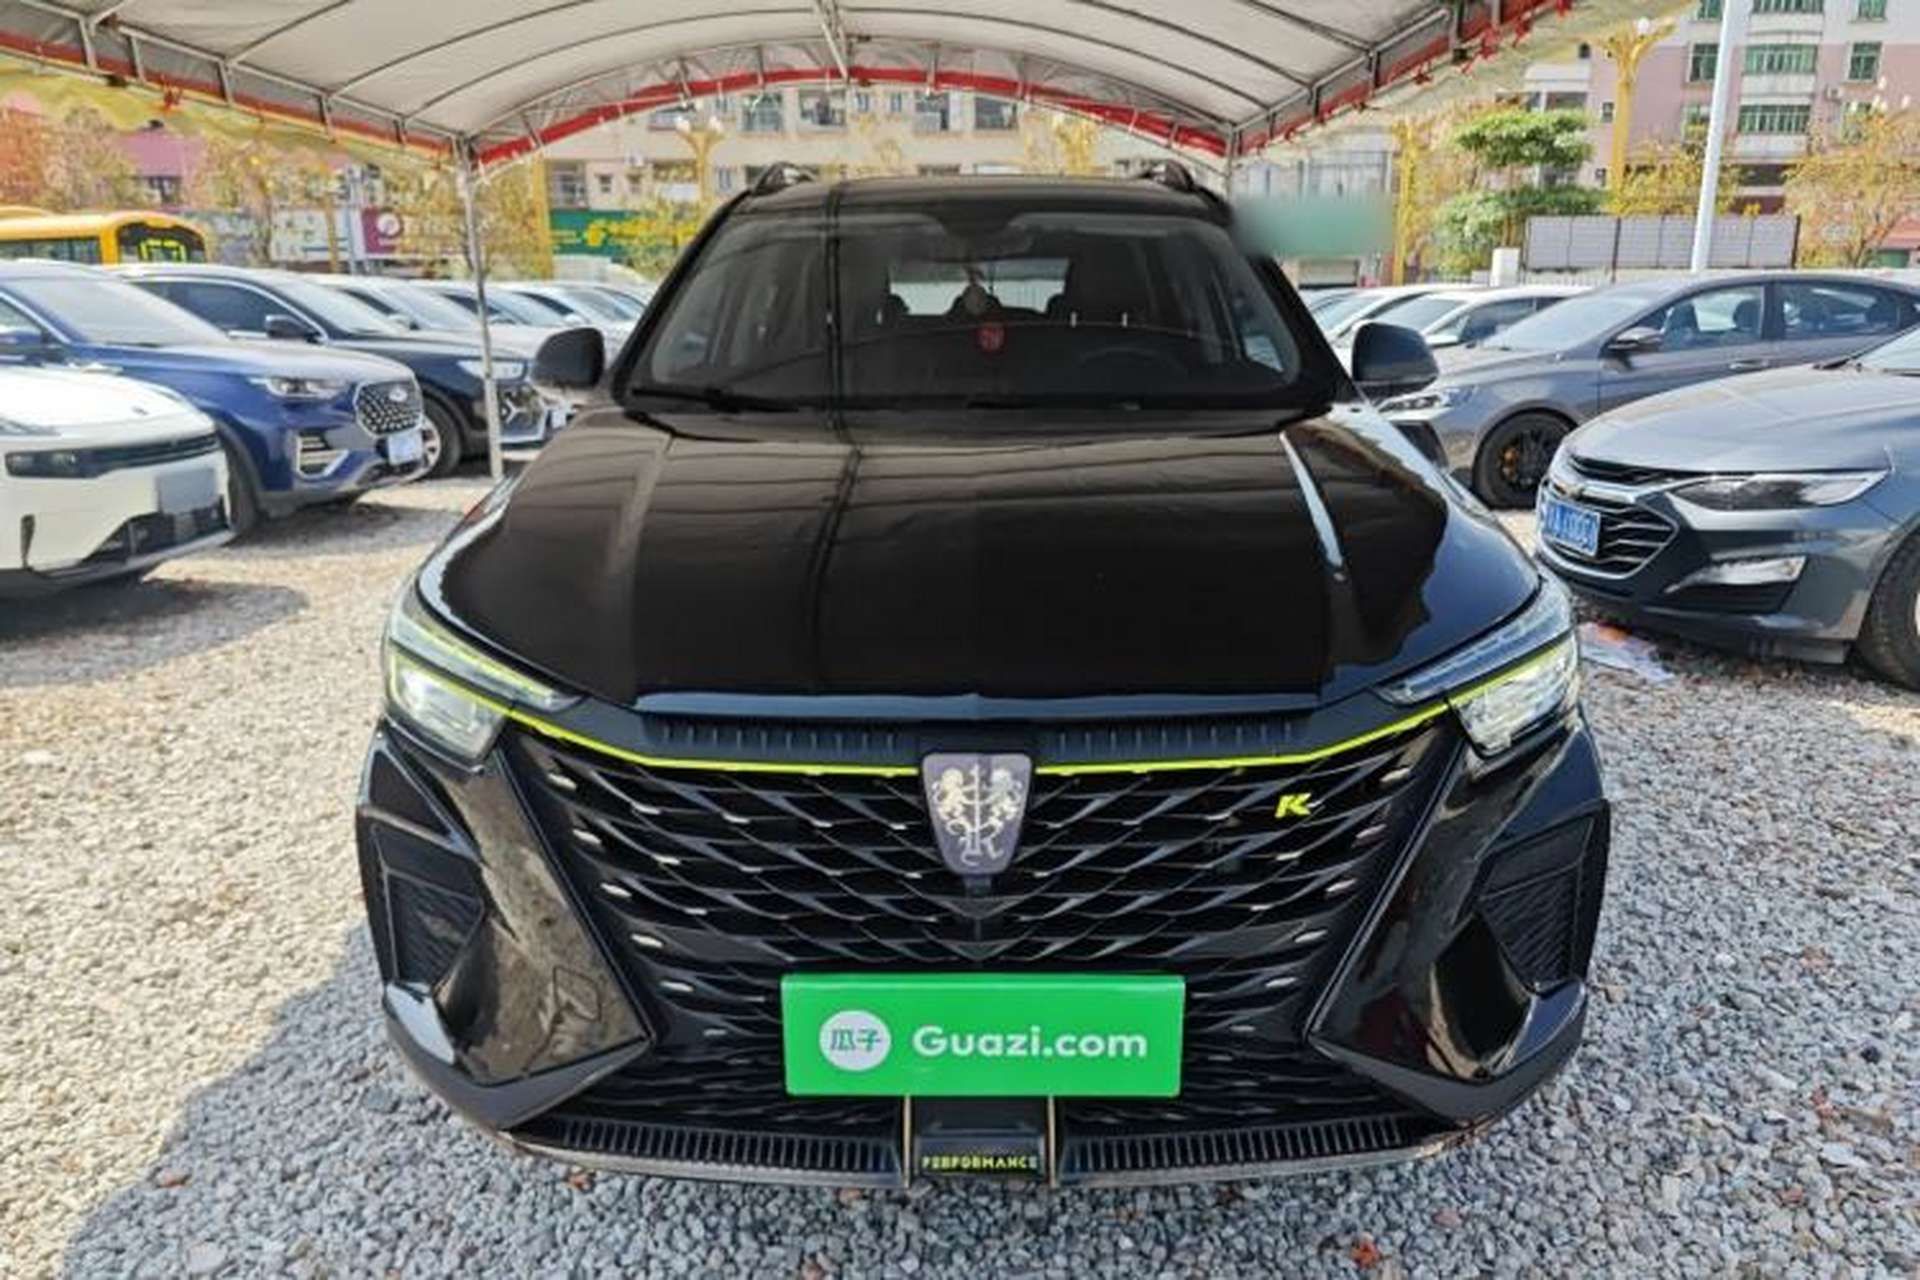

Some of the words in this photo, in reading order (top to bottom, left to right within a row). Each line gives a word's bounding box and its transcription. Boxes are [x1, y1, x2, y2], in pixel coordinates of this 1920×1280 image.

[830, 1028, 882, 1053] 瓜子
[912, 1025, 1148, 1058] Guazi.com
[921, 1155, 1038, 1169] PERFORMANCE
